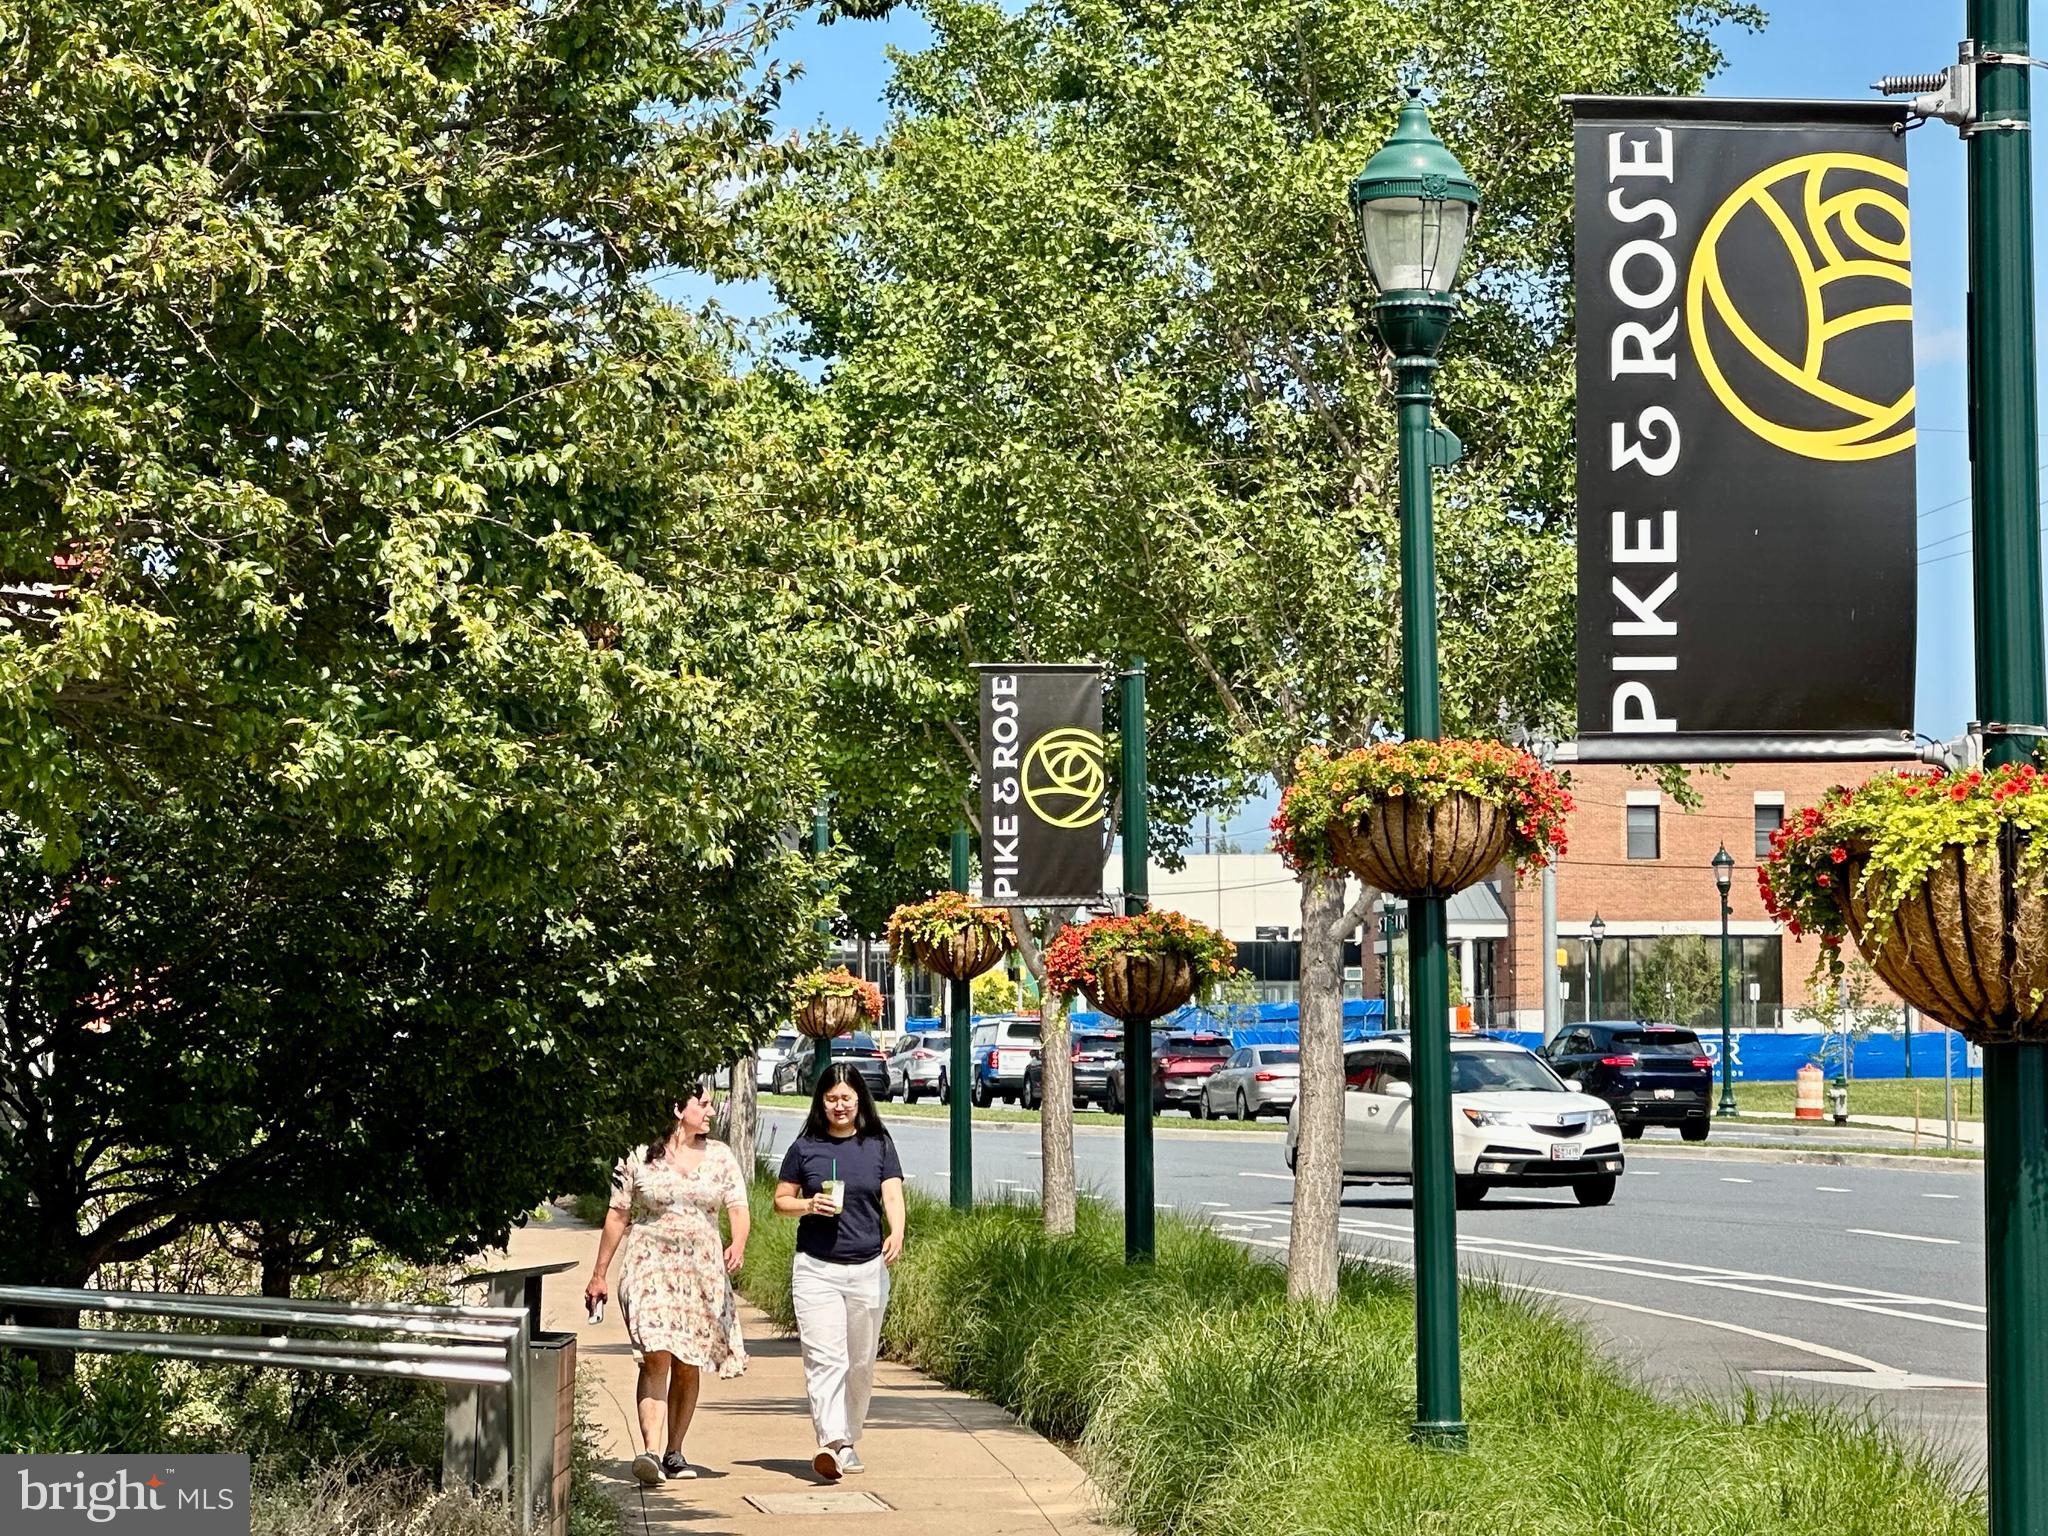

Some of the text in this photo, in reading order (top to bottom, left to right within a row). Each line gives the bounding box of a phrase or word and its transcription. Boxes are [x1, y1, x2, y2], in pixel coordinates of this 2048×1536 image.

[1608, 127, 1681, 734] PIKE & ROSE
[991, 675, 1020, 898] PIKE & ROSE
